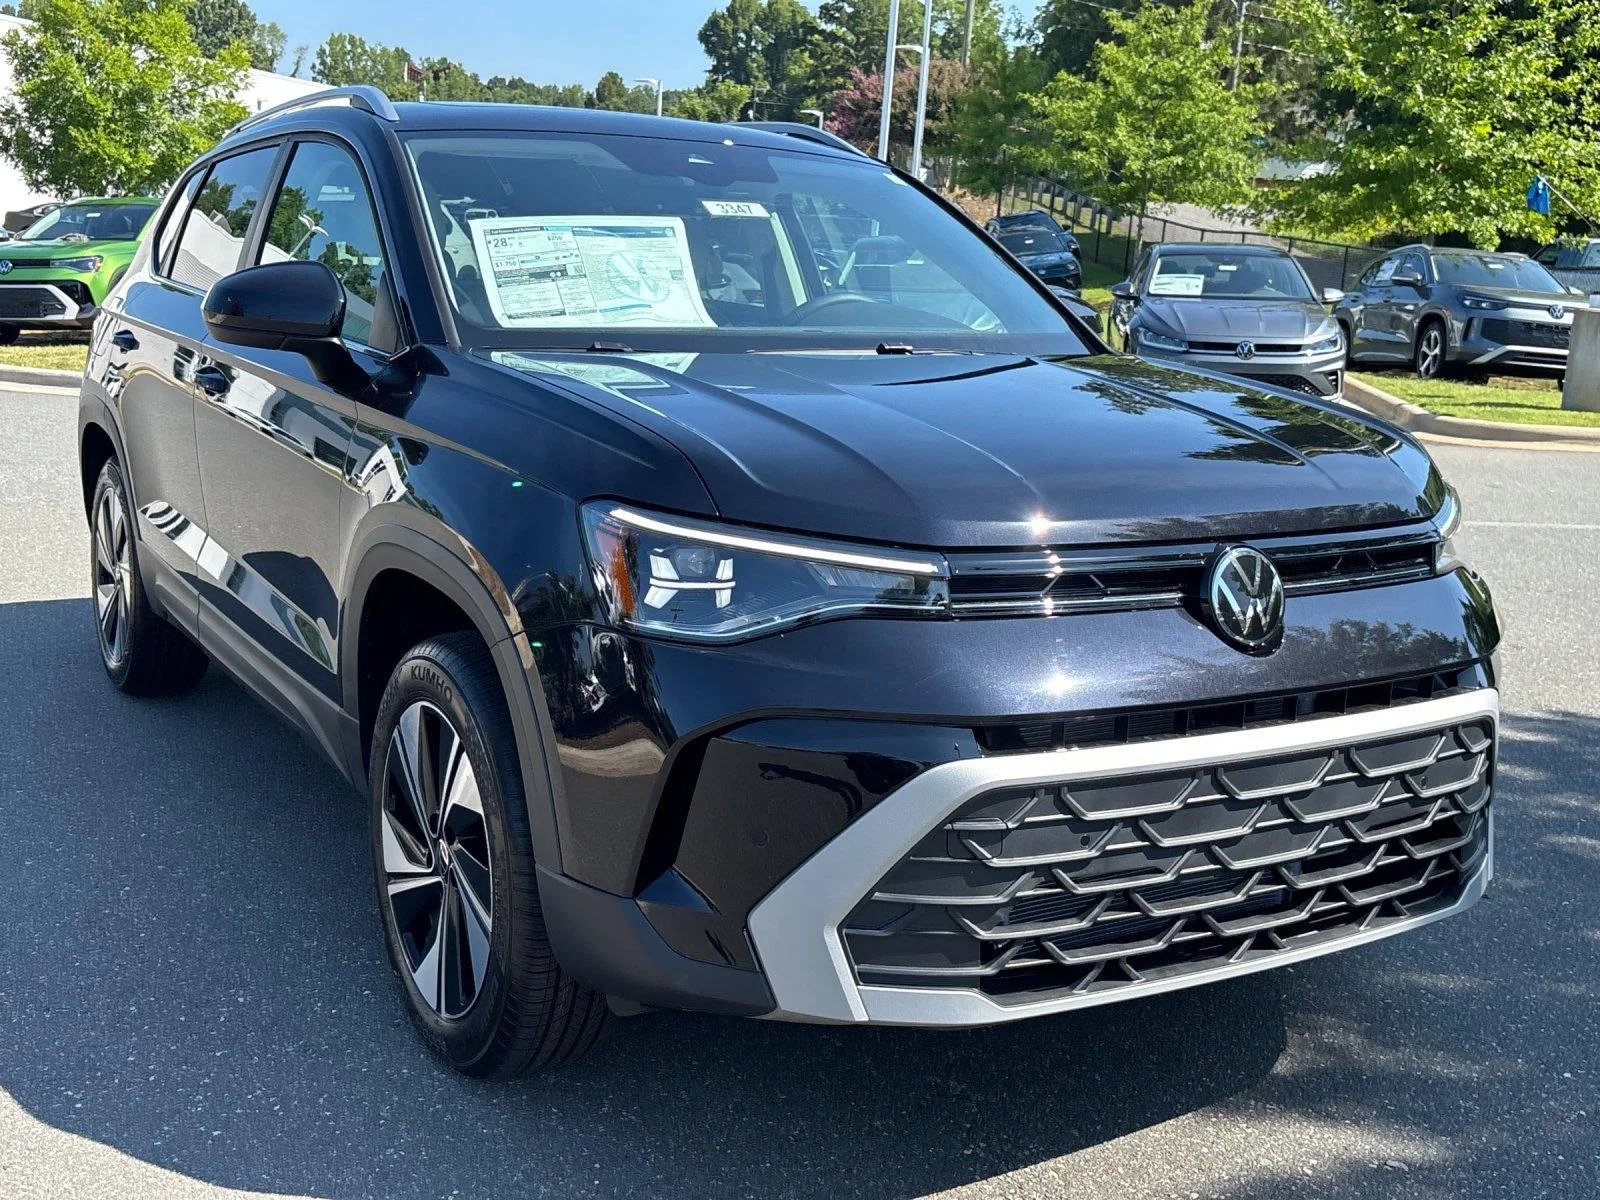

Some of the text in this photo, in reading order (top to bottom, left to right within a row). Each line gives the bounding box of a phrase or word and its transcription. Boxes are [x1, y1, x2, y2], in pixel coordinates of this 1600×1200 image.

[716, 203, 753, 215] 3347
[493, 237, 508, 248] 28
[411, 665, 453, 701] KUMHO
